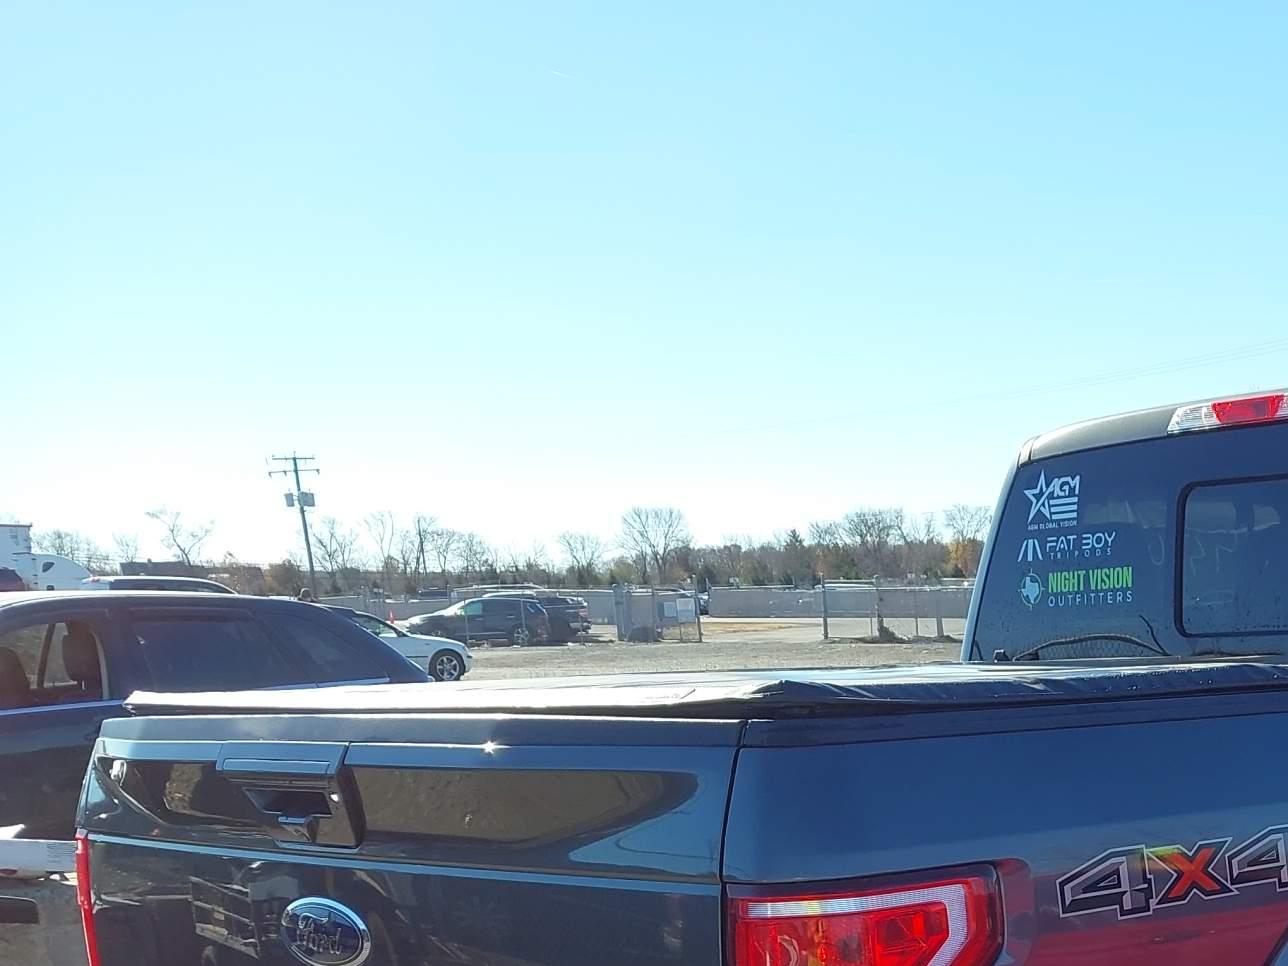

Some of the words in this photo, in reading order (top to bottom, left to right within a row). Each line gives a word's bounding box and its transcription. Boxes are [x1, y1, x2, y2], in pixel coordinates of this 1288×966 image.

[1046, 534, 1077, 552] FAT
[1081, 531, 1116, 550] BOY
[1050, 547, 1112, 560] TRIPODS
[1048, 570, 1086, 593] NIGHT
[1089, 565, 1133, 591] VISION
[1047, 590, 1133, 608] OUTFITTERS
[297, 911, 343, 956] Ford
